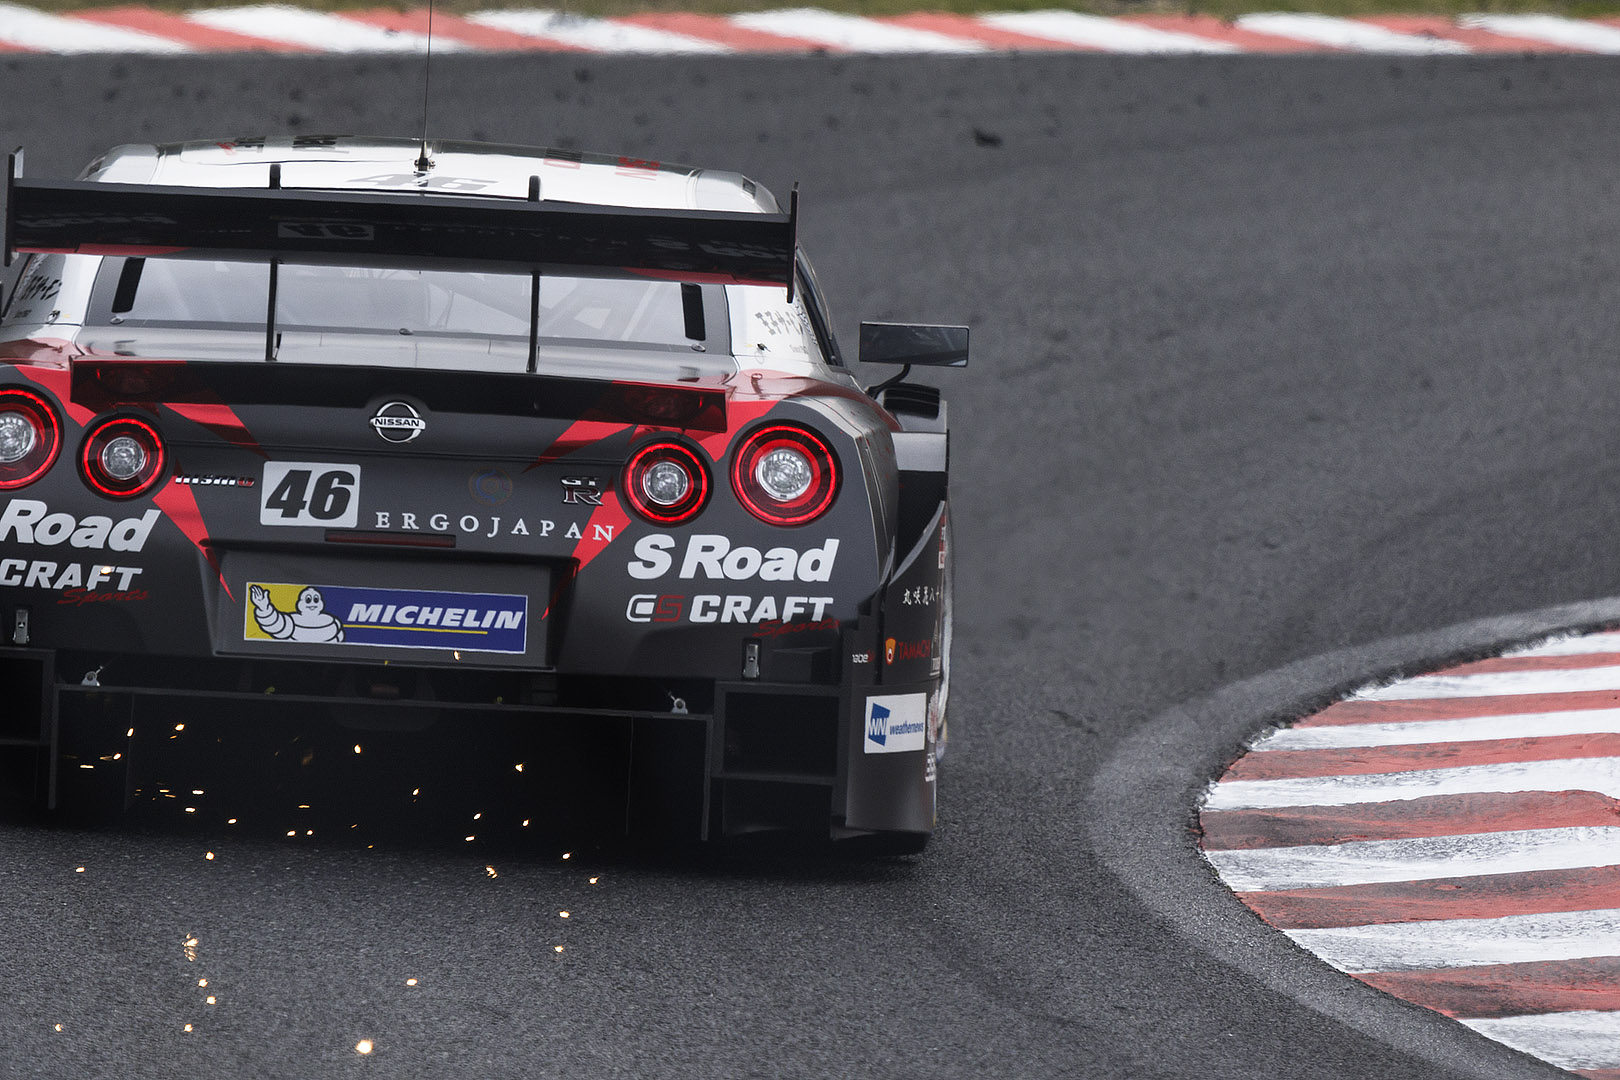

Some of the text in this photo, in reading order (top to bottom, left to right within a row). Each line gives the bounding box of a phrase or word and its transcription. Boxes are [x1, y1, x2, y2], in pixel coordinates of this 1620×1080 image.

[374, 417, 421, 428] NISSAN
[264, 469, 356, 521] 46
[0, 498, 162, 553] Road
[375, 511, 614, 543] ERGOJAPAN
[627, 533, 840, 582] S Road
[0, 558, 143, 592] CRAFT
[347, 602, 523, 630] MICHELIN
[688, 595, 834, 624] CRAFT
